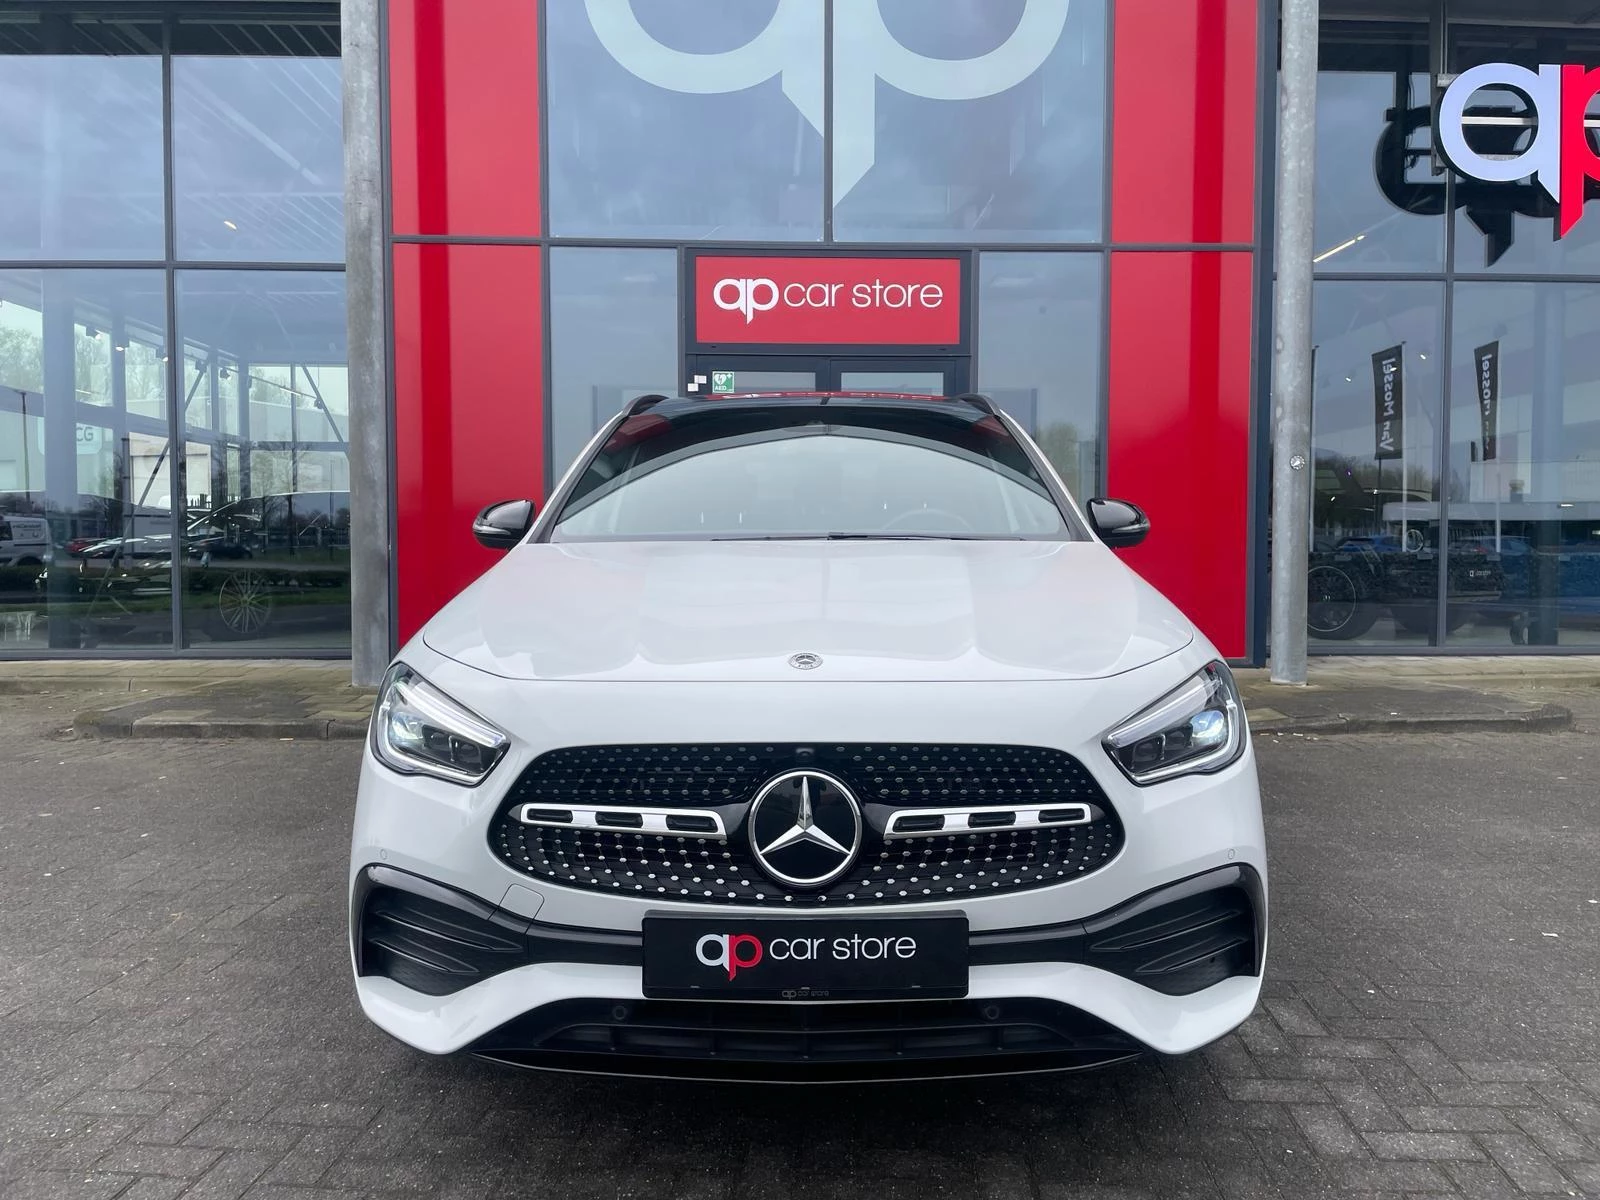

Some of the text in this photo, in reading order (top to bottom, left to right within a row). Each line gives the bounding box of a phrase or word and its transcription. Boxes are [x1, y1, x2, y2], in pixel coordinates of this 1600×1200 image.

[713, 278, 944, 325] ap car store
[695, 933, 917, 982] ap car store
